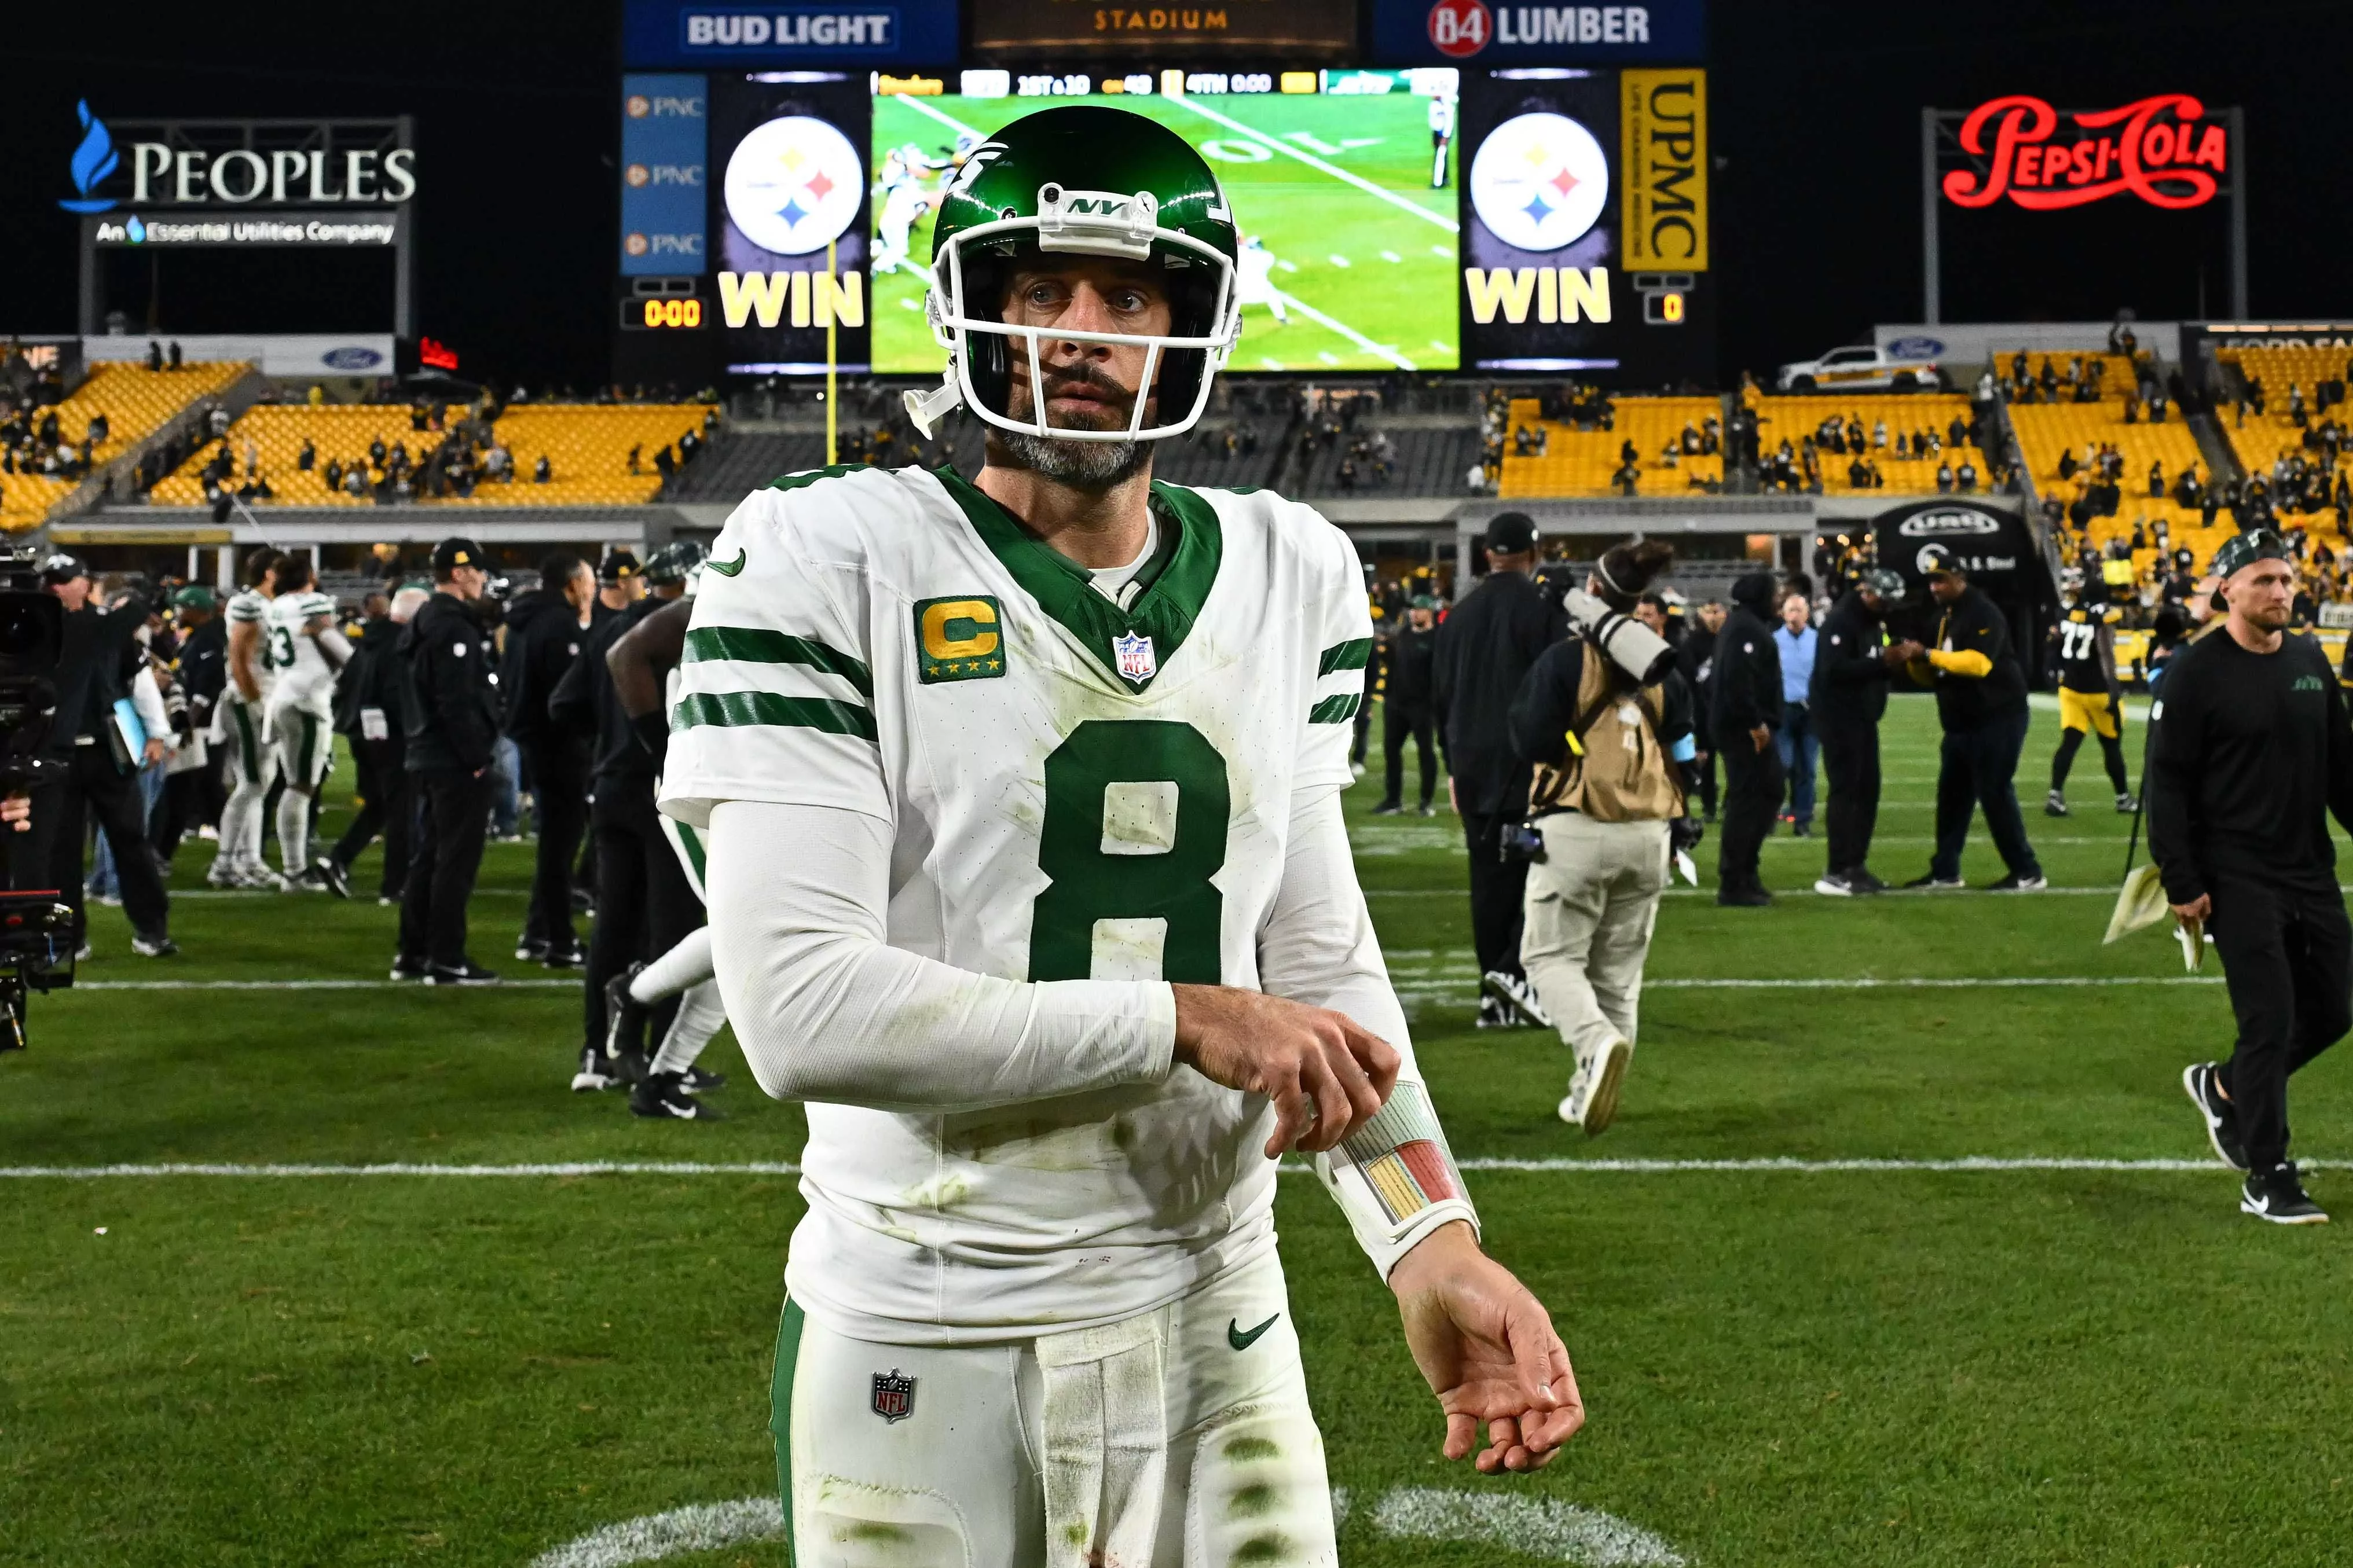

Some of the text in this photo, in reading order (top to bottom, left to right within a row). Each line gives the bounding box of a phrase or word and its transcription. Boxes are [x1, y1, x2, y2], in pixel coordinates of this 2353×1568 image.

[687, 15, 890, 45] BUD LIGHT
[1094, 9, 1229, 31] STADIUM
[1435, 6, 1650, 45] 84 LUMBER
[653, 97, 705, 117] PNC
[652, 165, 704, 185] PNC
[1650, 82, 1698, 259] UPMC
[1067, 198, 1127, 215] NY
[96, 221, 396, 245] An Essential Utilities Company
[651, 233, 703, 254] PNC
[718, 270, 864, 328] WIN
[1465, 266, 1612, 324] WIN
[1663, 293, 1683, 322] 0
[922, 600, 998, 660] C
[2059, 619, 2095, 660] 77
[1122, 654, 1150, 674] NFL
[1028, 719, 1231, 985] 8
[877, 1391, 907, 1413] NFL
